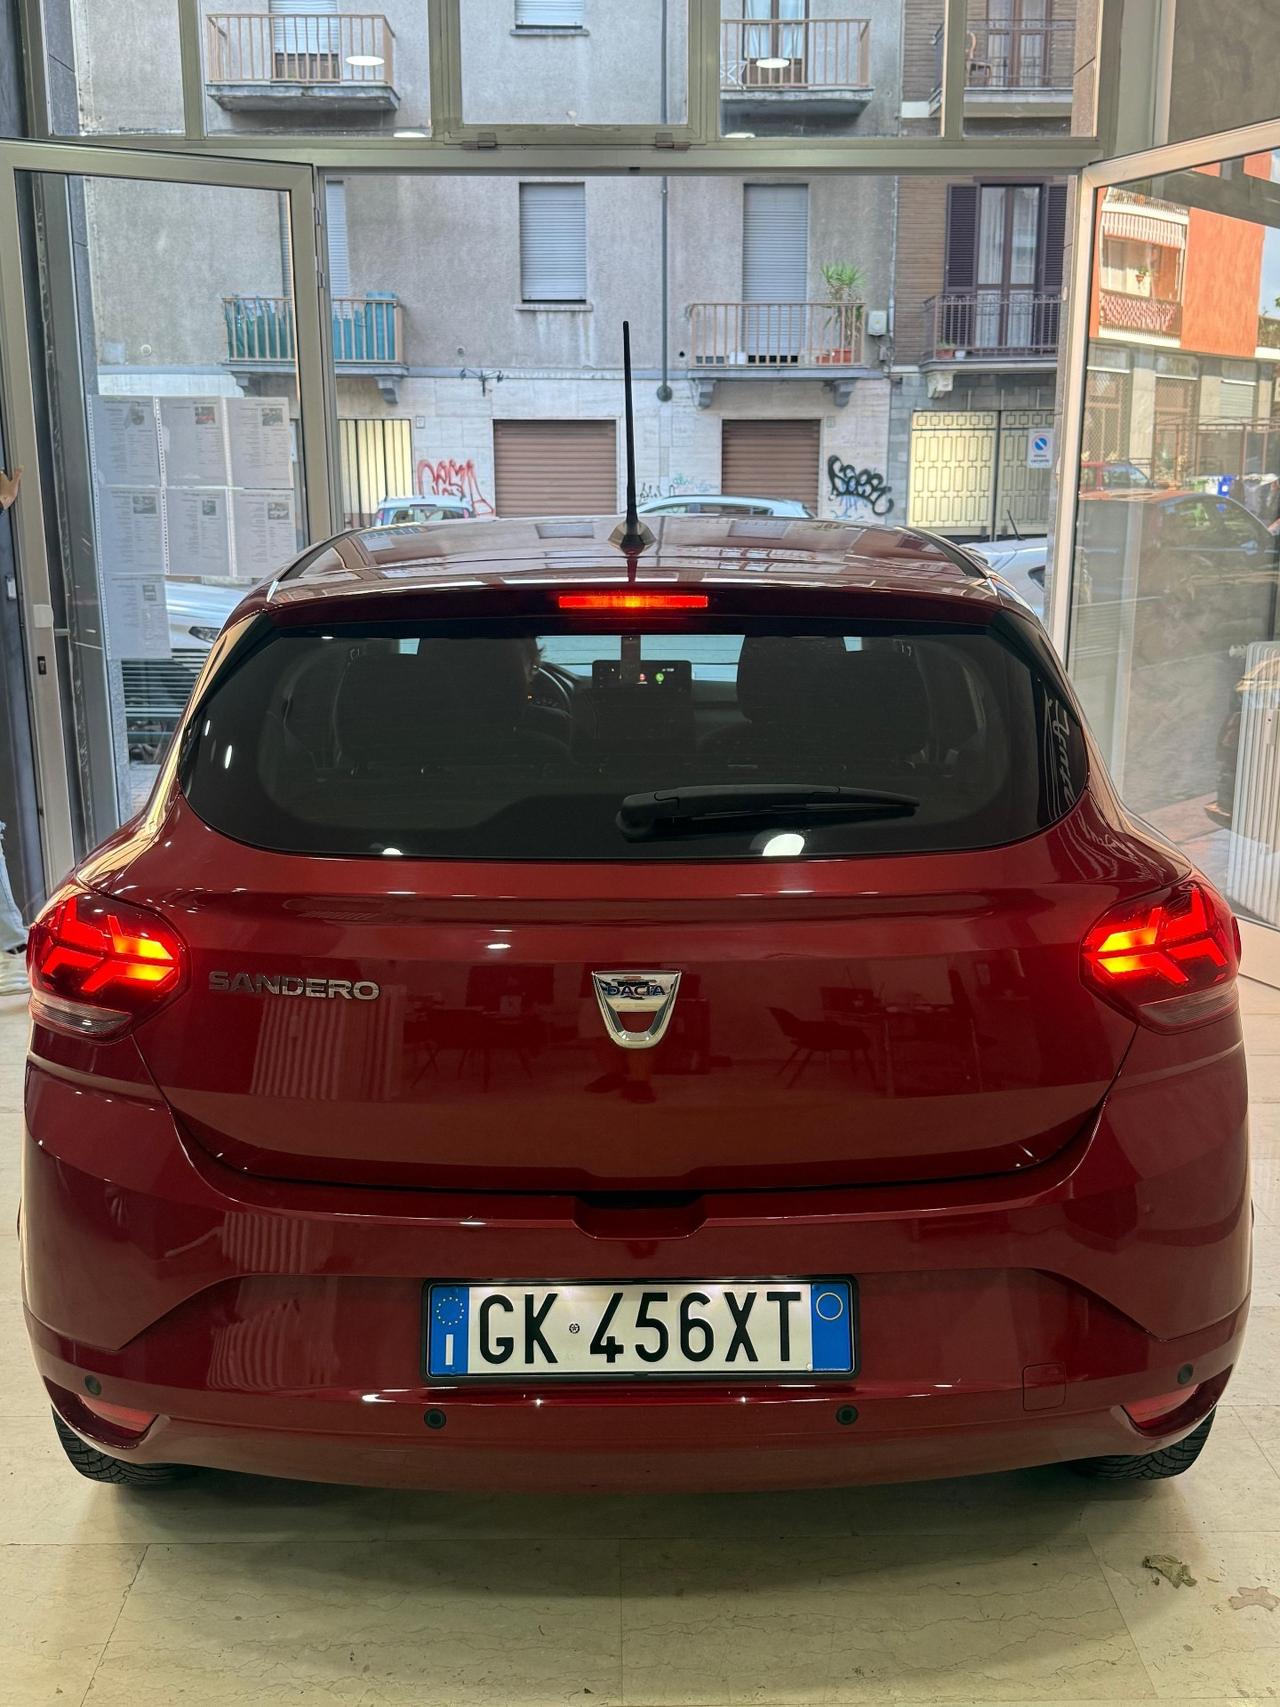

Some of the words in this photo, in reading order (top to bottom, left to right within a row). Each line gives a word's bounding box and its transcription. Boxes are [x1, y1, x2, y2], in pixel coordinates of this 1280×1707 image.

[208, 970, 380, 1001] SANDERO
[607, 984, 666, 996] DACIA
[479, 1293, 559, 1365] GK
[589, 1292, 801, 1364] 456XT
